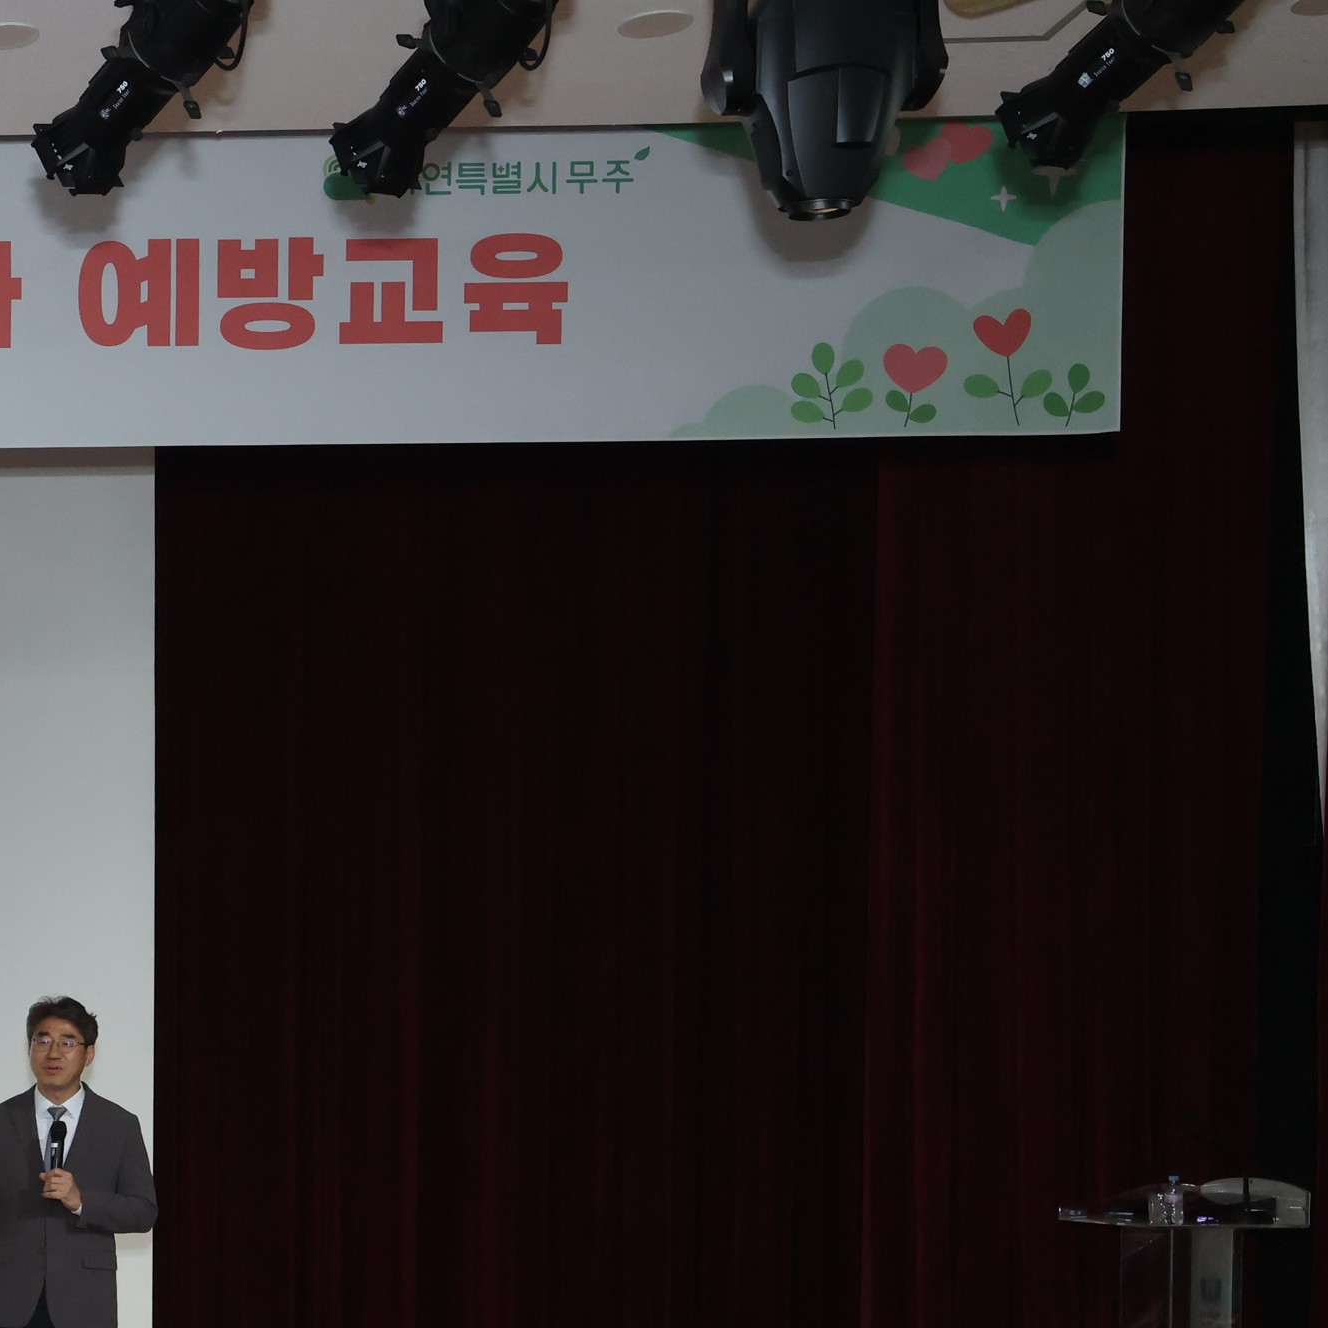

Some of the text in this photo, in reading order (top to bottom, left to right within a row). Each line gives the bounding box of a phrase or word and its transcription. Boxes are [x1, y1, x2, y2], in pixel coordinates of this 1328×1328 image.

[410, 159, 635, 196] 연특별시 무주
[77, 232, 569, 351] 예방교육
